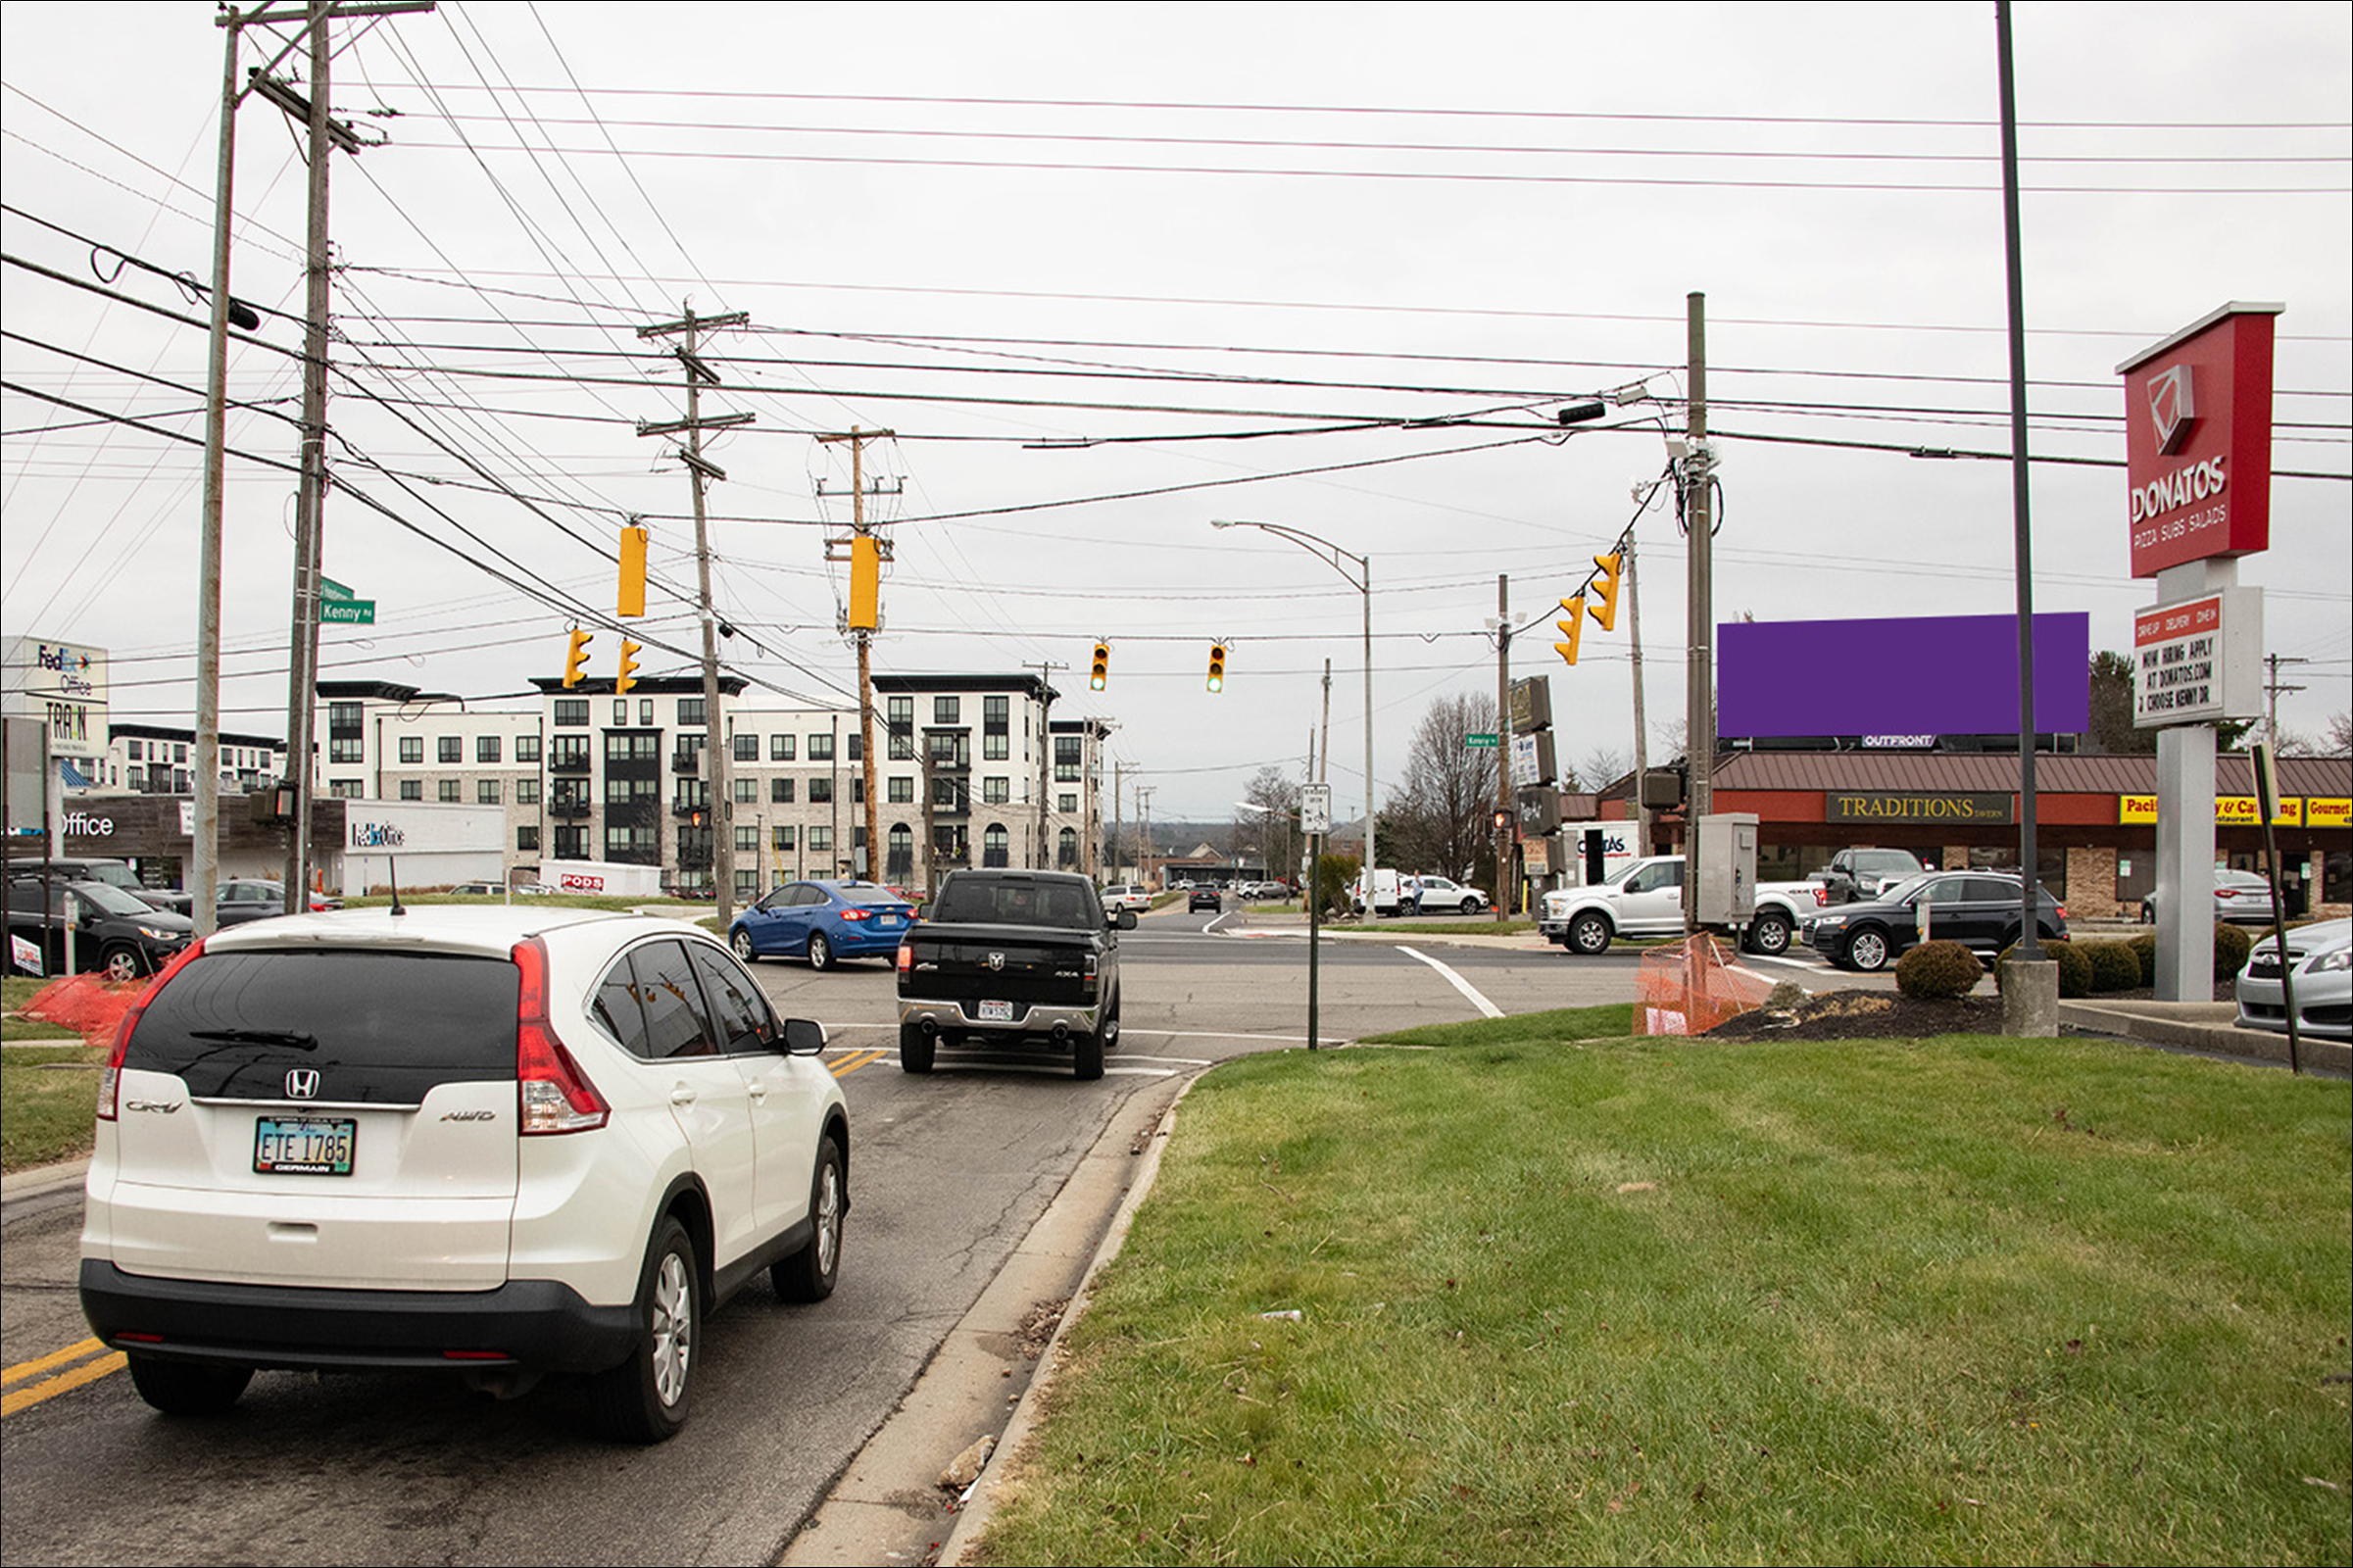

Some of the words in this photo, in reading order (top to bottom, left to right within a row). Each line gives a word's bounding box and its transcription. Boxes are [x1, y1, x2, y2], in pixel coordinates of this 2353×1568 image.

[2132, 455, 2227, 524] DONATOS
[2134, 529, 2157, 549] PIZZA
[2161, 518, 2185, 541] SUBS
[2188, 504, 2227, 532] SALADS
[323, 604, 362, 622] Kenny
[39, 645, 78, 672] FedEx
[2189, 637, 2213, 660] APPLY
[61, 674, 92, 697] Office
[2146, 671, 2158, 691] AT
[2159, 661, 2213, 689] DONATOS.COM
[2147, 690, 2175, 712] CHOOSE
[2176, 687, 2198, 708] KENNY
[2199, 685, 2211, 705] DR
[1864, 735, 1933, 747] OUTFRONT
[1838, 797, 1974, 818] TRADITIONS
[2127, 799, 2158, 812] Paci
[2310, 801, 2350, 815] Gourmet
[563, 876, 603, 887] PODS
[439, 1110, 496, 1122] AWD
[262, 1133, 296, 1160] ETE
[303, 1134, 347, 1162] 1785
[274, 1163, 330, 1173] GERMAIN
